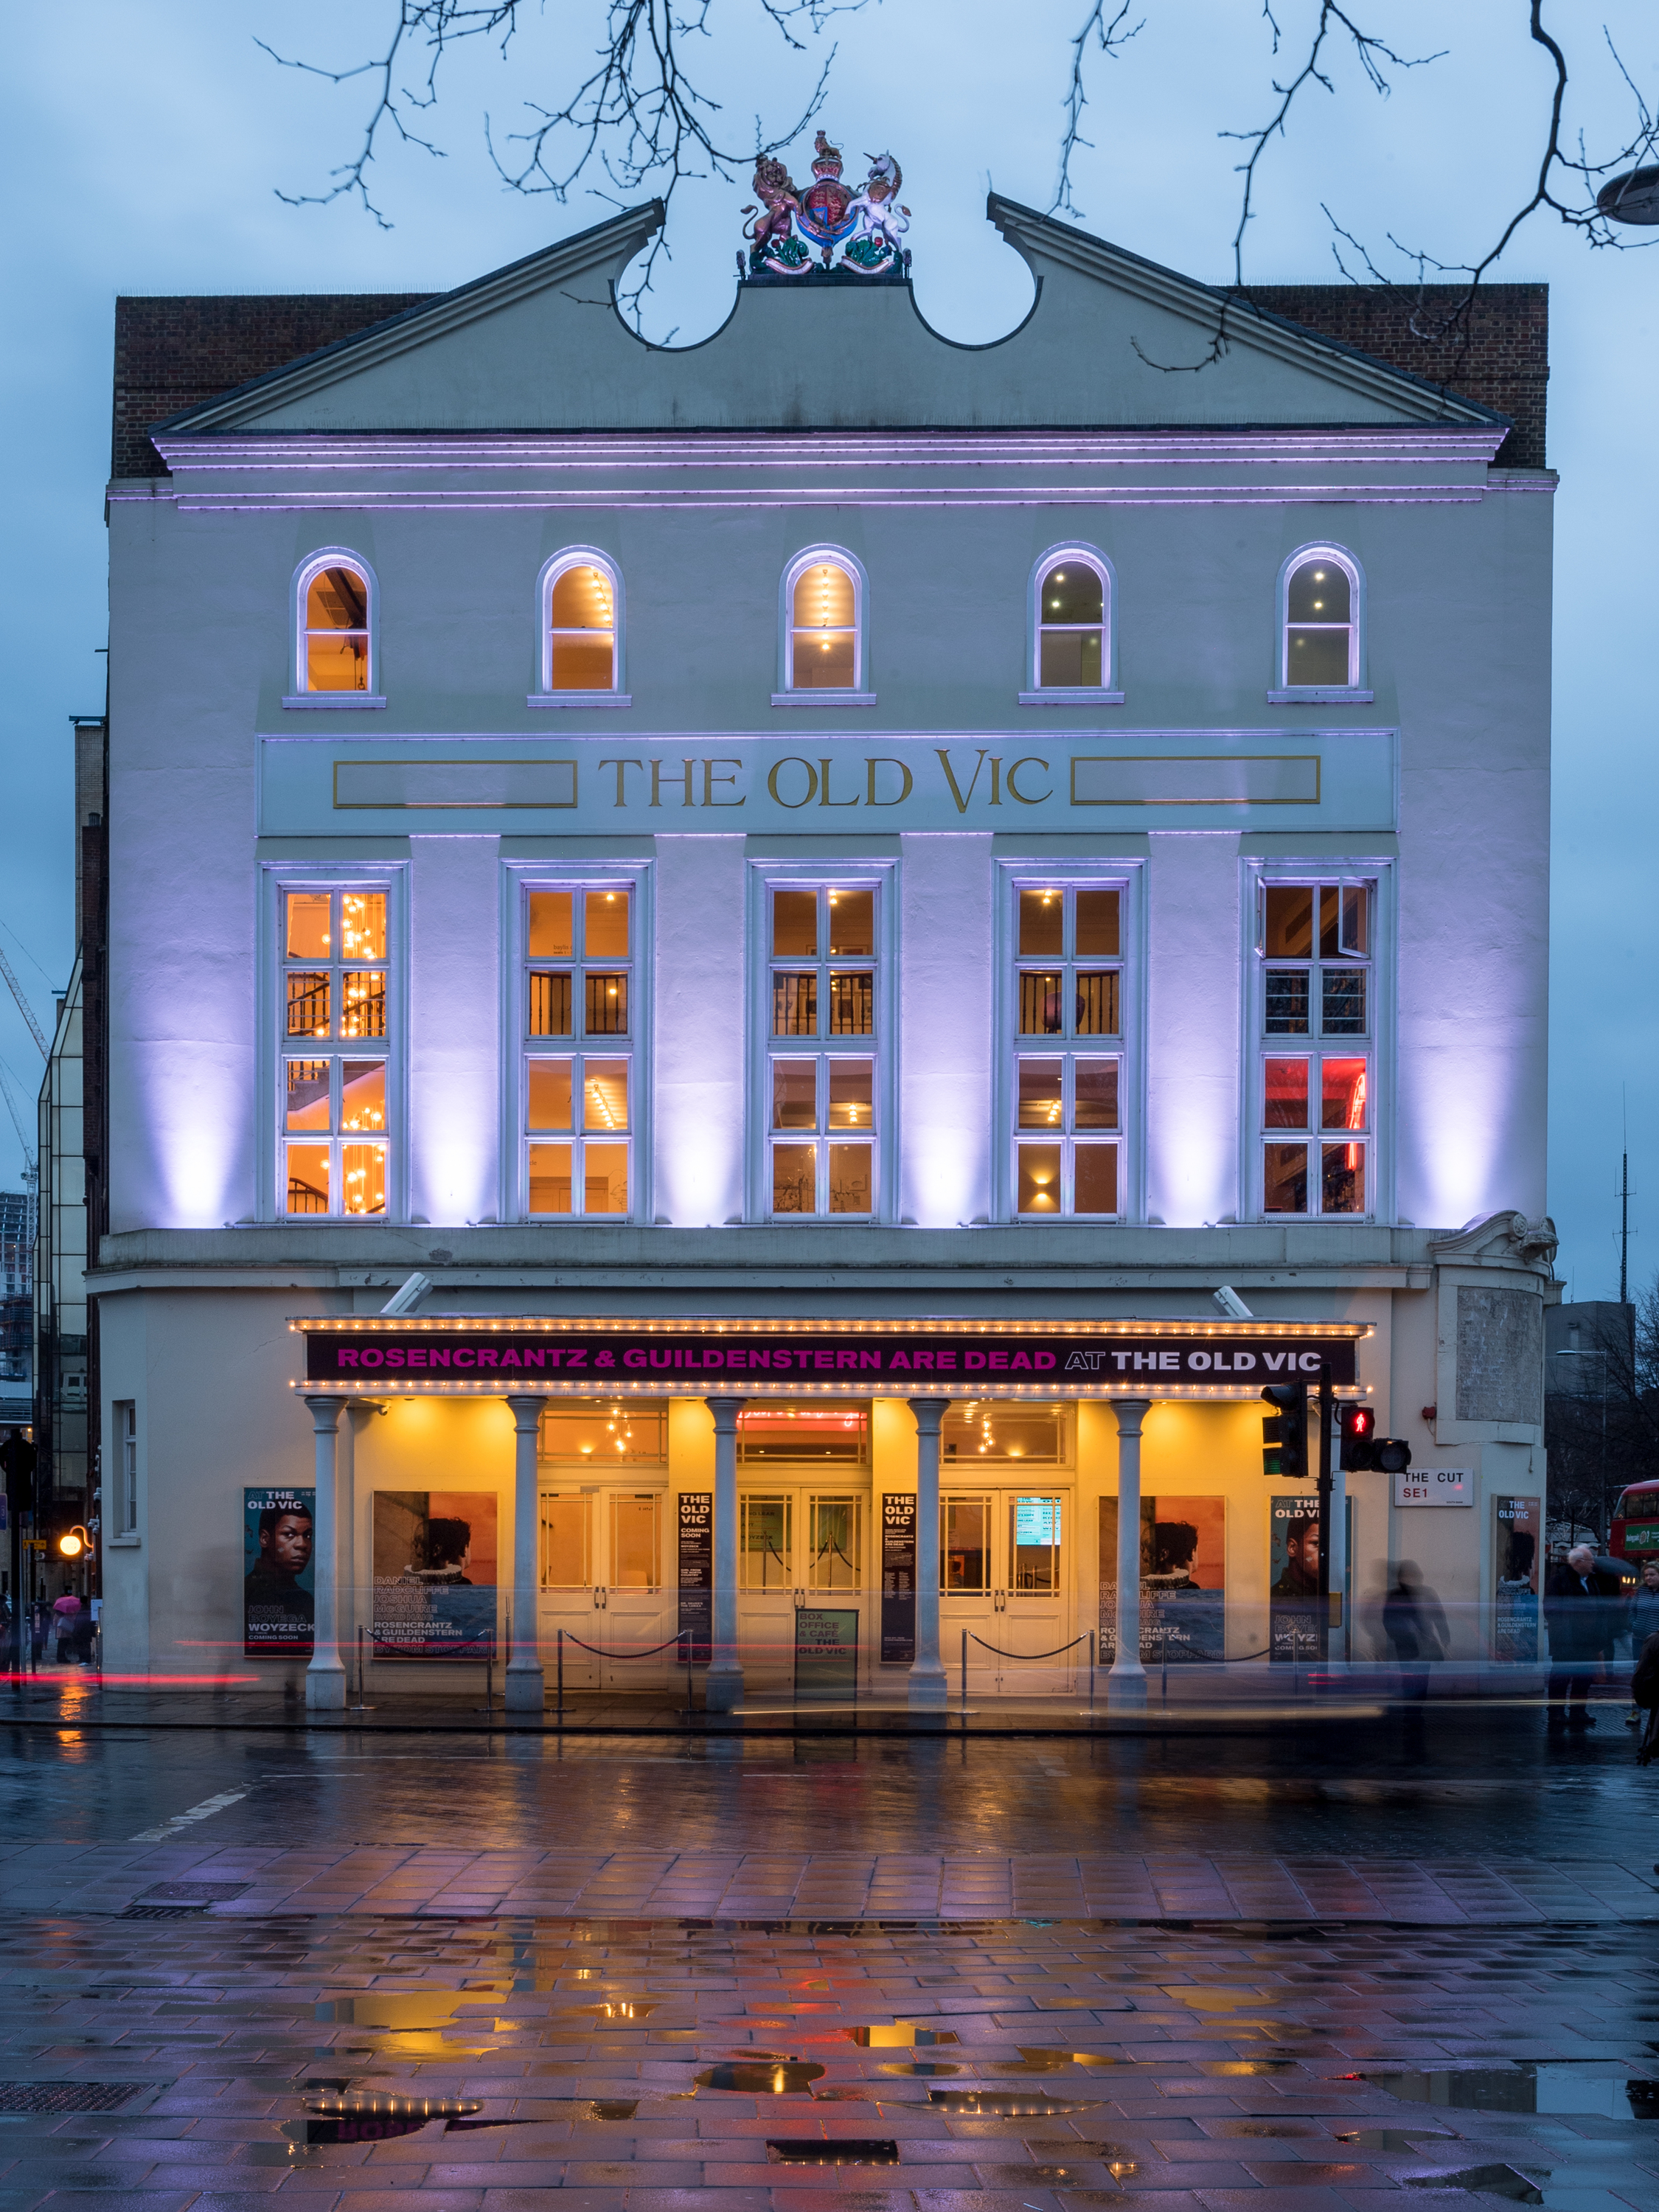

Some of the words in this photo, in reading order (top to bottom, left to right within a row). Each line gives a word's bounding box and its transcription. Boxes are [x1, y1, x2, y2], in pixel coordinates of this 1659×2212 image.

[598, 759, 746, 807] THE
[768, 757, 914, 808] OLD
[338, 1348, 588, 1368] ROSENCRANTZ
[594, 1349, 616, 1368] &
[623, 1349, 882, 1369] GUILDENSTERN
[888, 1351, 958, 1369] ARE
[964, 1351, 1057, 1370] DEAD
[1064, 1351, 1106, 1370] AT
[1111, 1352, 1180, 1370] THE
[1188, 1352, 1256, 1371] OLD
[1262, 1352, 1322, 1371] VIC
[1403, 1472, 1429, 1482] THE
[1437, 1472, 1464, 1483] CUT
[248, 1491, 265, 1499] AT
[266, 1491, 295, 1500] THE
[1403, 1488, 1427, 1498] SE1
[681, 1495, 710, 1503] THE
[885, 1496, 914, 1505] THE
[248, 1500, 276, 1509] OLD
[277, 1500, 303, 1509] VIC
[1275, 1500, 1293, 1508] AT
[1509, 1500, 1525, 1509] THE
[681, 1505, 710, 1514] OLD
[885, 1506, 914, 1514] OLD
[1275, 1509, 1304, 1517] OLD
[1498, 1509, 1514, 1518] OLD
[1515, 1511, 1529, 1519] VIC
[681, 1514, 706, 1523] VIC
[885, 1516, 911, 1525] VIC
[374, 1576, 423, 1585] DANIEL
[374, 1586, 449, 1595] RADCLIFFE
[374, 1595, 427, 1604] JOSHUA
[248, 1605, 284, 1614] JOHN
[374, 1604, 437, 1613] McGUIRE
[248, 1614, 307, 1623] BOYEGA
[1274, 1615, 1311, 1624] JOHN
[248, 1623, 315, 1632] WOYZECK
[810, 1629, 838, 1637] CAFÉ
